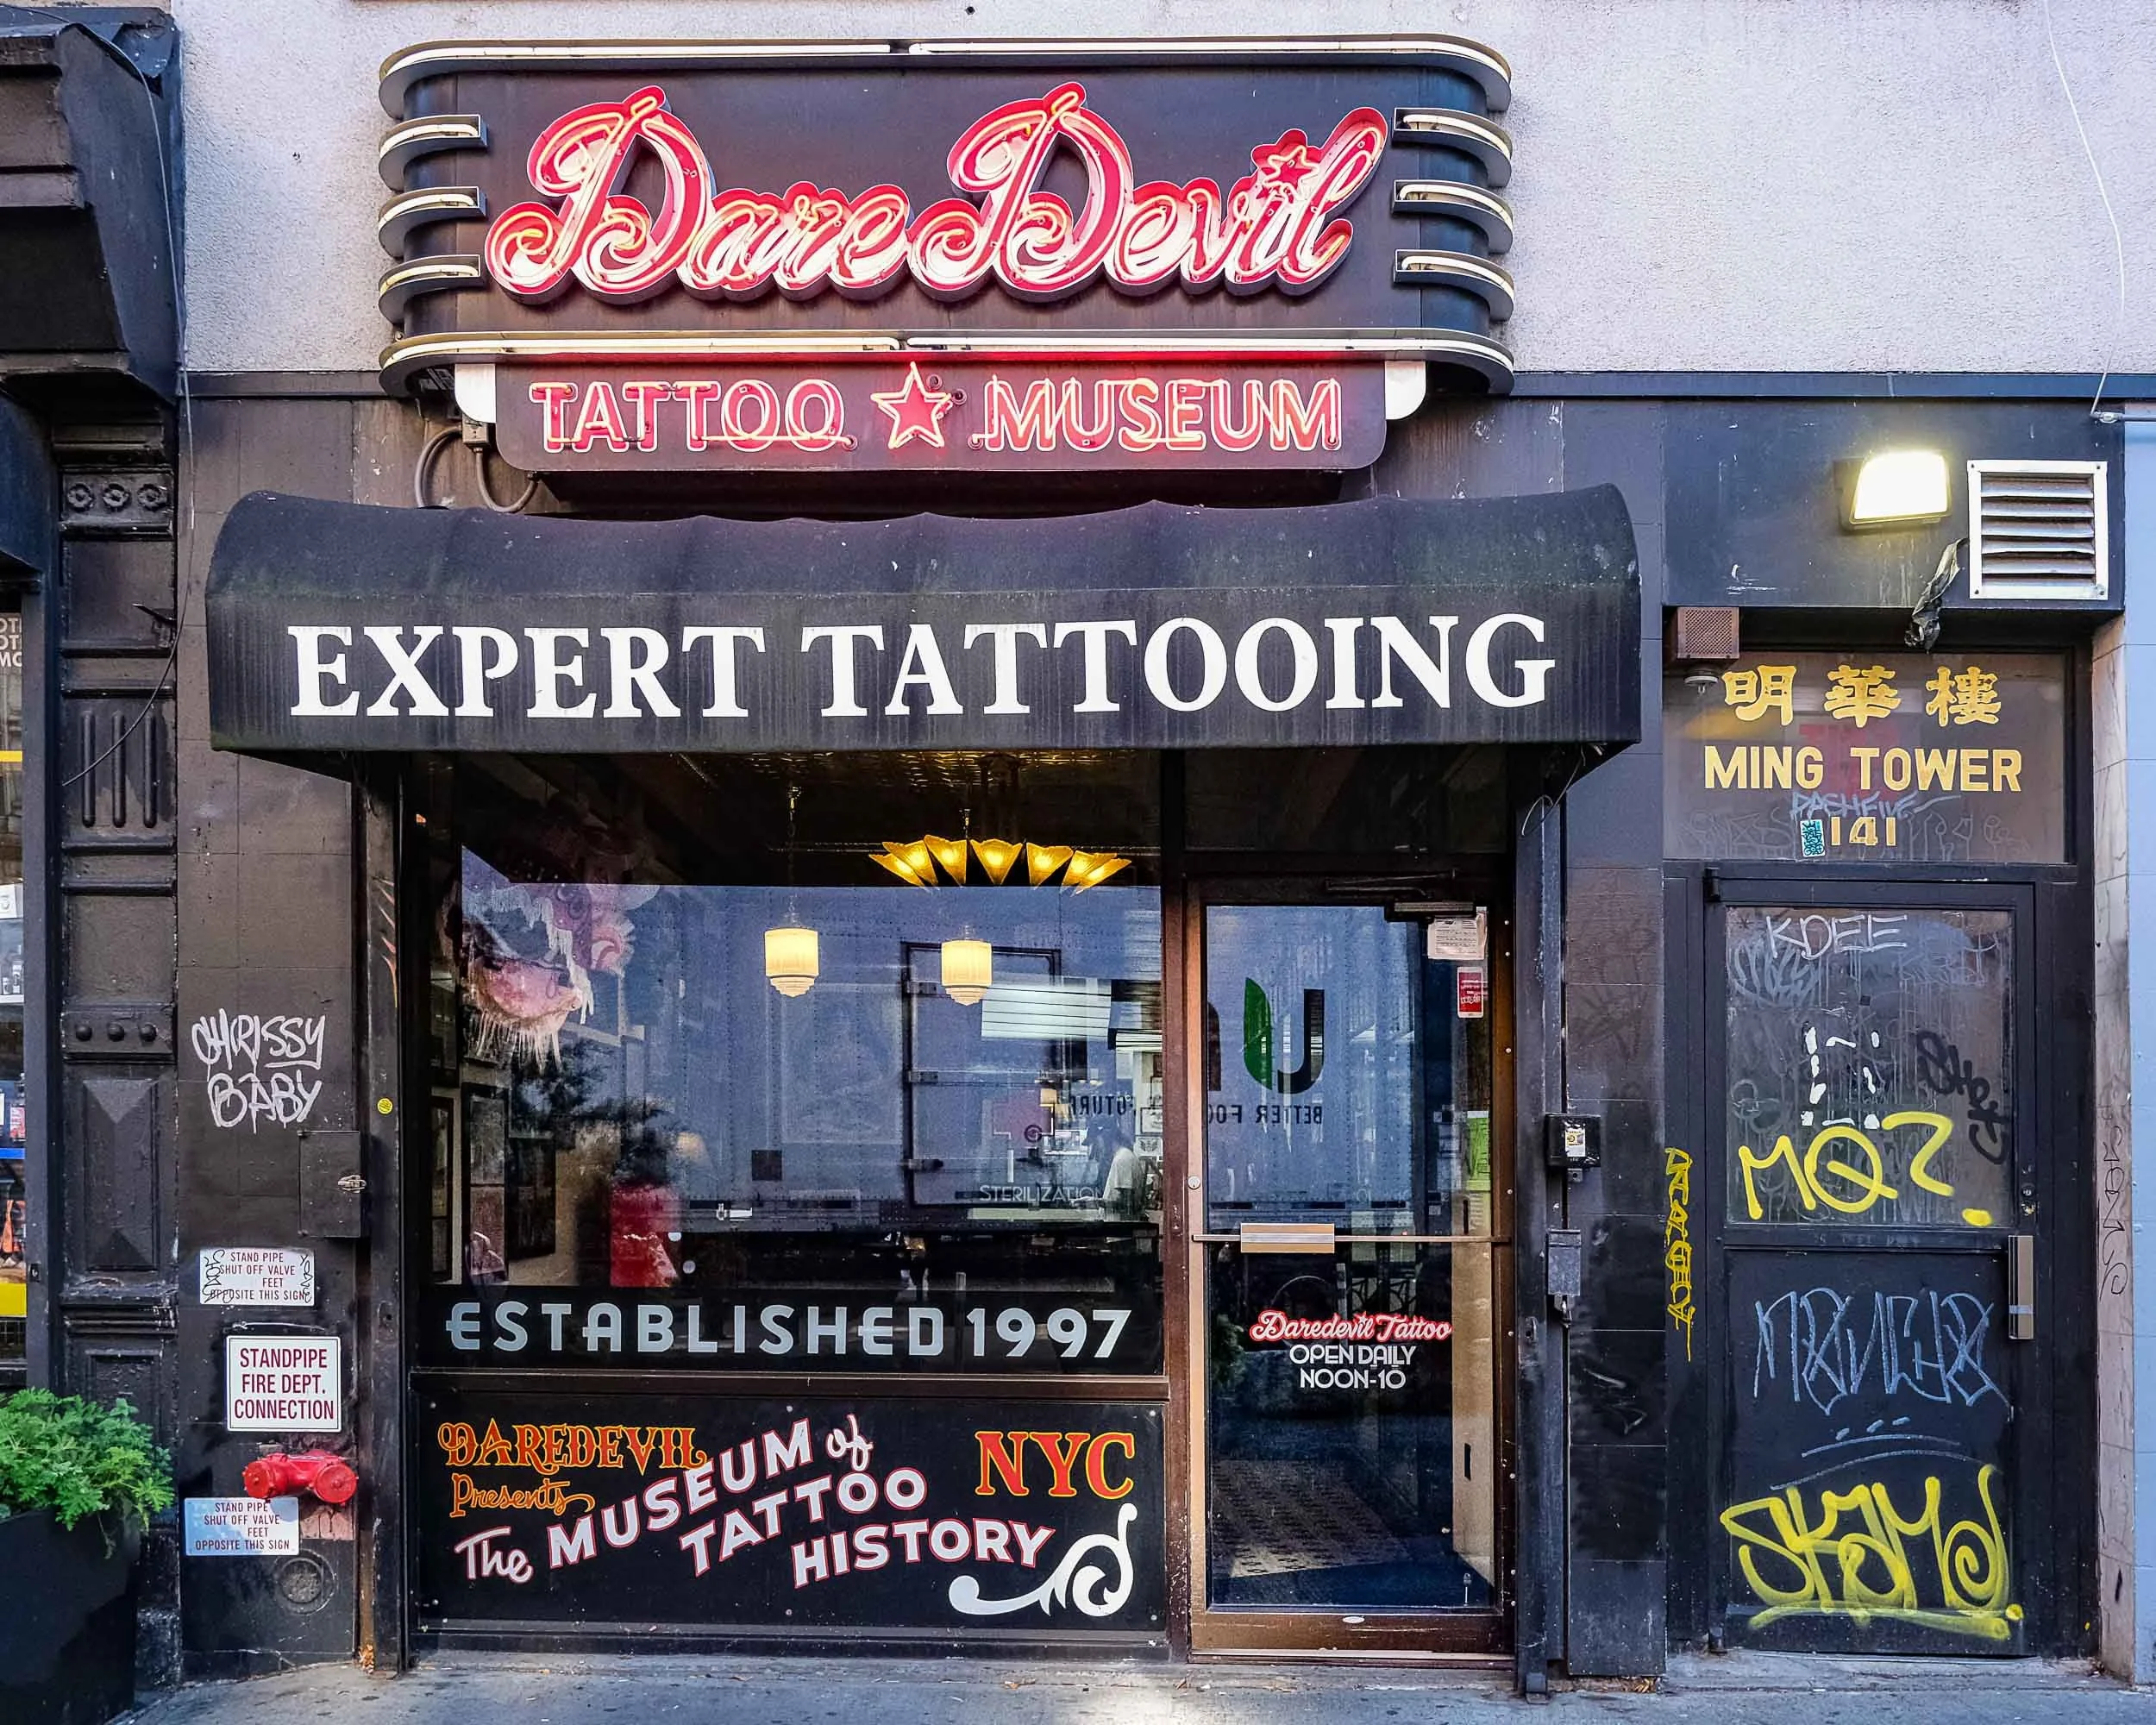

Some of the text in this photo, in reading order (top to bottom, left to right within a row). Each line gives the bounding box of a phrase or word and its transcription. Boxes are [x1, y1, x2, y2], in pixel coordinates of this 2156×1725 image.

[529, 378, 1343, 454] TATTOO MUSEUM
[287, 612, 1556, 719] EXPERT TATTOOING
[1721, 664, 2002, 728] 明華樓
[1704, 745, 2022, 792] MING TOWER
[1830, 816, 1897, 846] 141
[207, 1070, 323, 1129] BABY
[220, 1264, 295, 1276] SHUT OFF VALVE
[230, 1251, 284, 1263] STAND PIPE
[259, 1289, 279, 1300] THIS
[283, 1290, 304, 1301] SIGN
[262, 1277, 283, 1288] FEET
[445, 1301, 1132, 1358] ESTABLISHED 1997
[1375, 1311, 1453, 1342] Tattoo
[240, 1347, 328, 1369] STANDPIPE
[1289, 1344, 1417, 1367] OPEN DAILY
[241, 1373, 326, 1395] FIRE DEPT.
[1300, 1367, 1407, 1389] NOON-10
[234, 1398, 335, 1421] CONNECTION
[437, 1417, 708, 1476] DAREDEVIL
[975, 1430, 1136, 1500] NYC
[215, 1502, 269, 1513] STAND PIPE
[449, 1472, 595, 1518] Presents
[454, 1413, 874, 1584] The MUSEUM of
[204, 1515, 280, 1526] SHUT OFF VALVE
[248, 1527, 269, 1538] FEET
[680, 1466, 928, 1578] TATTOO
[196, 1539, 290, 1551] OPPOSITE THIS SIGN
[791, 1517, 1056, 1590] HISTORY
